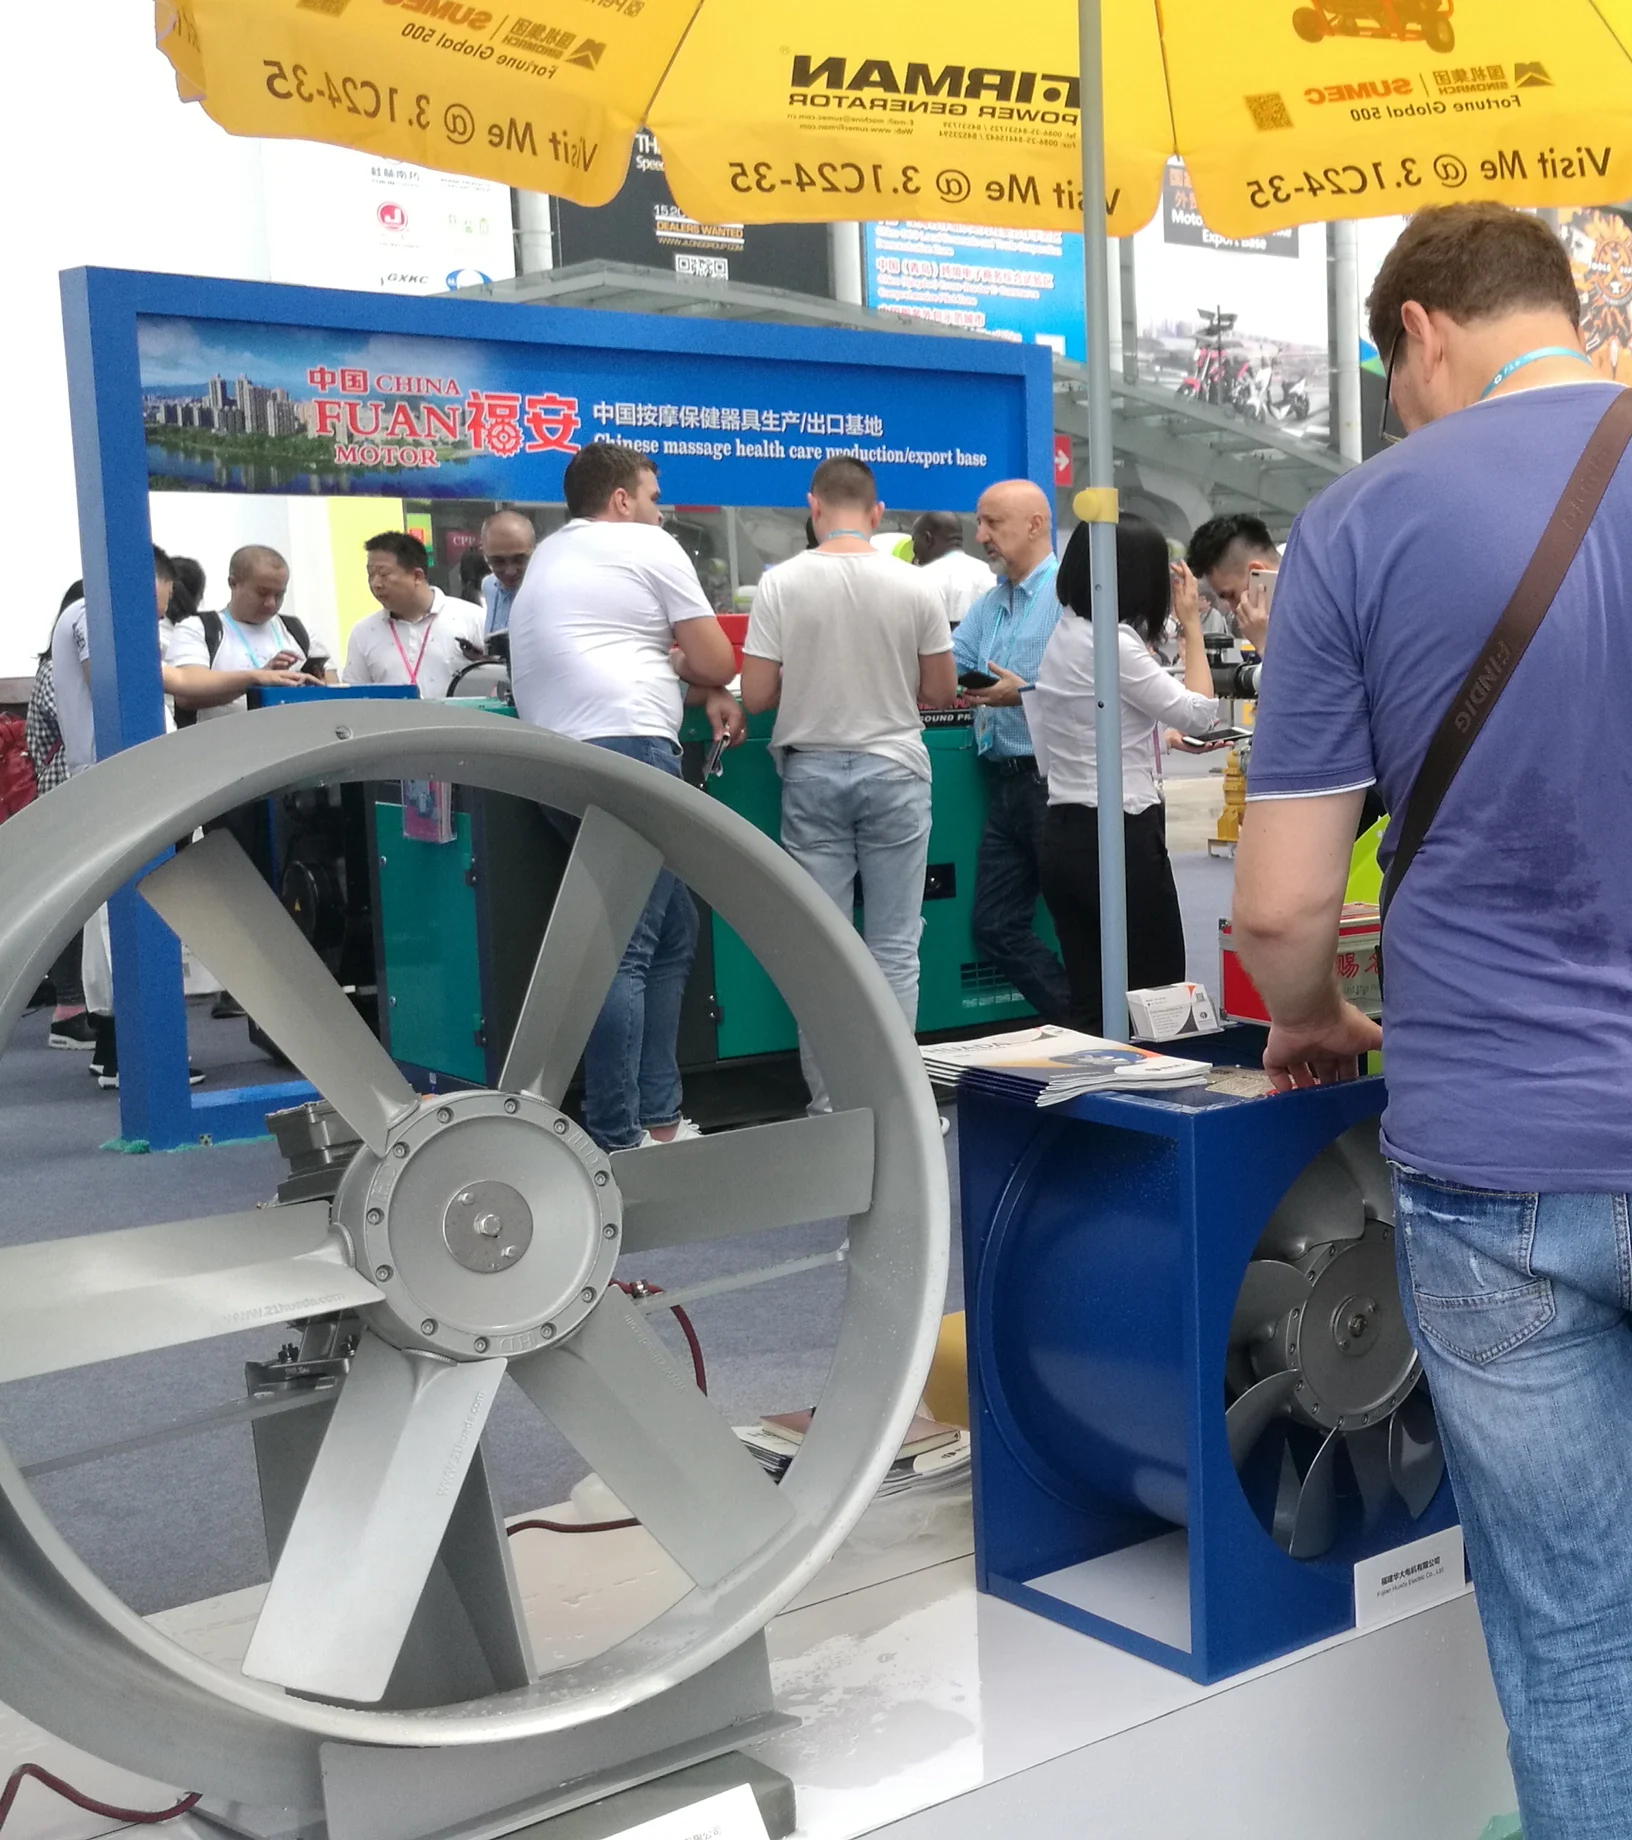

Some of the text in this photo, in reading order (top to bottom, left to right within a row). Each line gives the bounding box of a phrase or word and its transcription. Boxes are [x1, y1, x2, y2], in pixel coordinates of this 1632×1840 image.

[635, 133, 661, 154] TH
[656, 221, 744, 238] DEALERS WANTED
[308, 367, 462, 397] 中国 CHINA
[313, 390, 582, 458] FUAN 福安
[593, 401, 884, 437] 中国按摩保健器具生产/出口基地
[335, 444, 440, 467] MOTOR
[663, 439, 732, 460] massage
[735, 437, 786, 458] health
[789, 445, 823, 460] care
[956, 448, 987, 467] base
[1454, 638, 1512, 734] FINDIG
